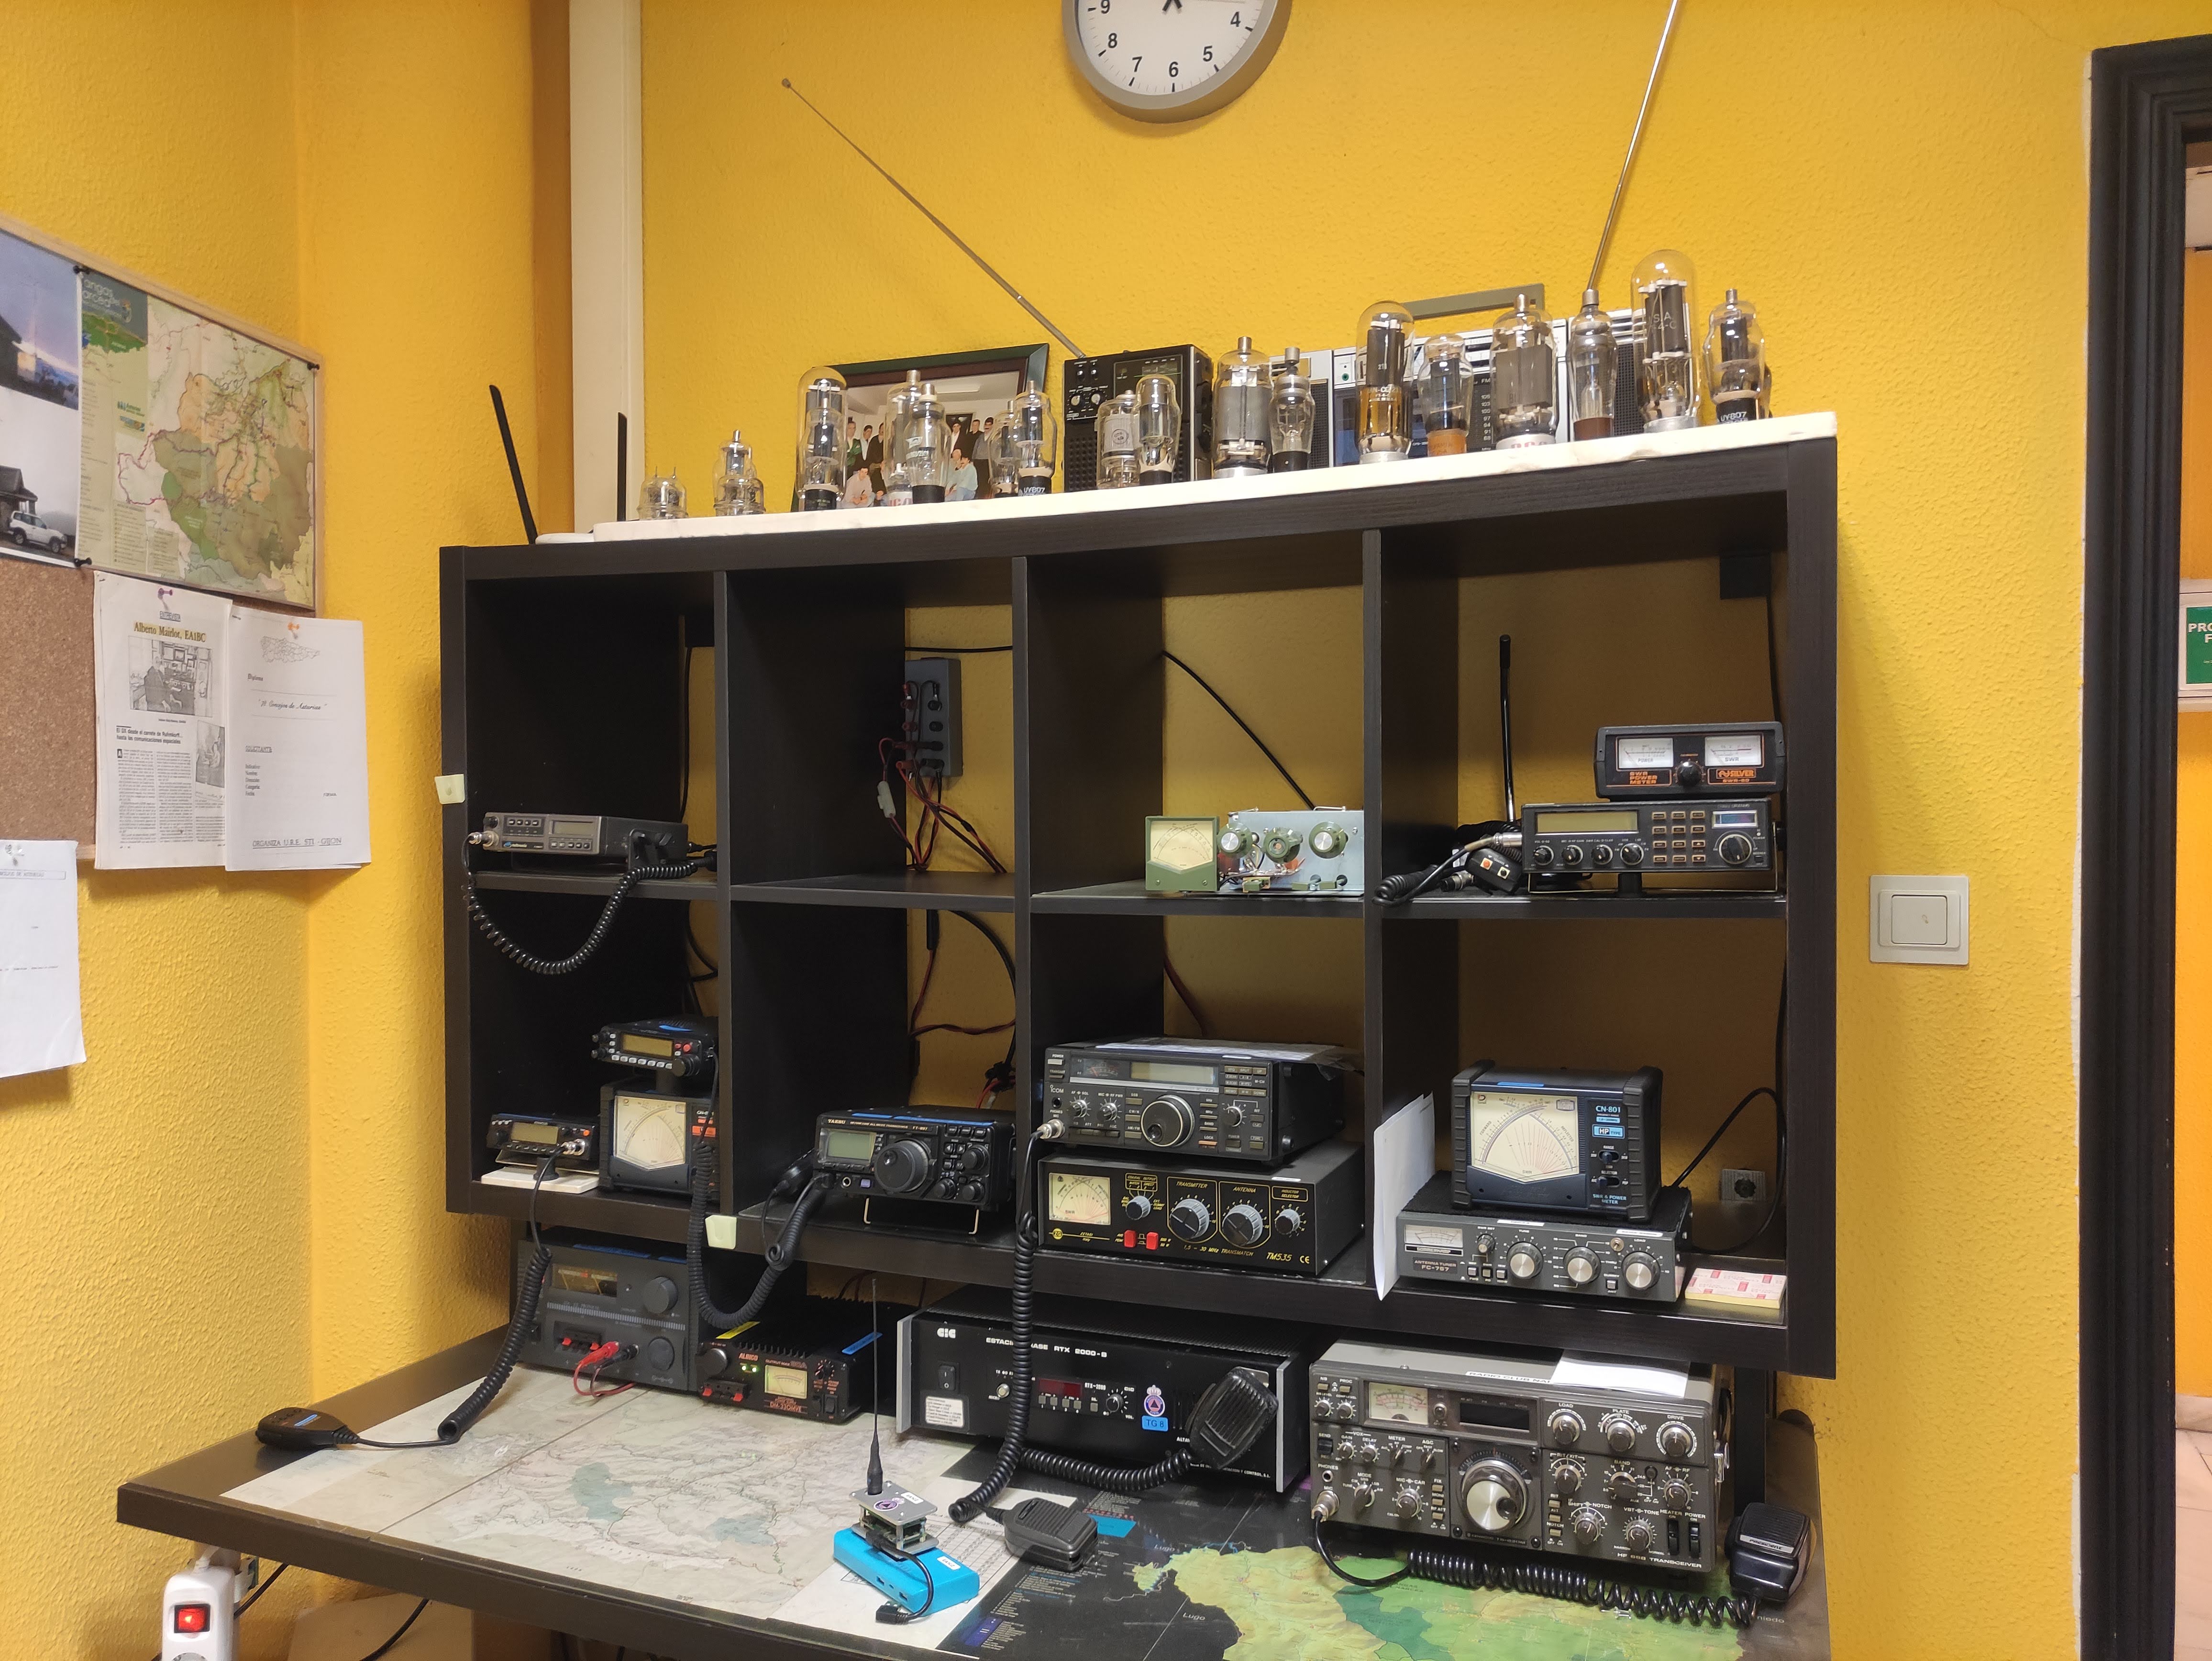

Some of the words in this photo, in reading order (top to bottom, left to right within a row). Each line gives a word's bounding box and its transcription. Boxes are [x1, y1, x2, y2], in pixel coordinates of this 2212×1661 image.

[1230, 11, 1241, 27] 4
[1108, 33, 1117, 48] 8
[1203, 46, 1213, 61] 5
[1132, 56, 1142, 72] 7
[1169, 62, 1179, 77] 6
[134, 621, 157, 635] Alberto
[185, 630, 206, 642] EA1BC
[1595, 1105, 1621, 1113] CN-801
[1221, 1248, 1253, 1257] TRANSMATCH
[1266, 1252, 1292, 1262] TM535
[986, 1337, 1013, 1346] ESTACI
[1075, 1348, 1107, 1357] 2000-B
[739, 1352, 758, 1361] ALINCO
[1649, 1557, 1702, 1568] TRANSCEIVER
[1183, 1612, 1206, 1620] Lugo
